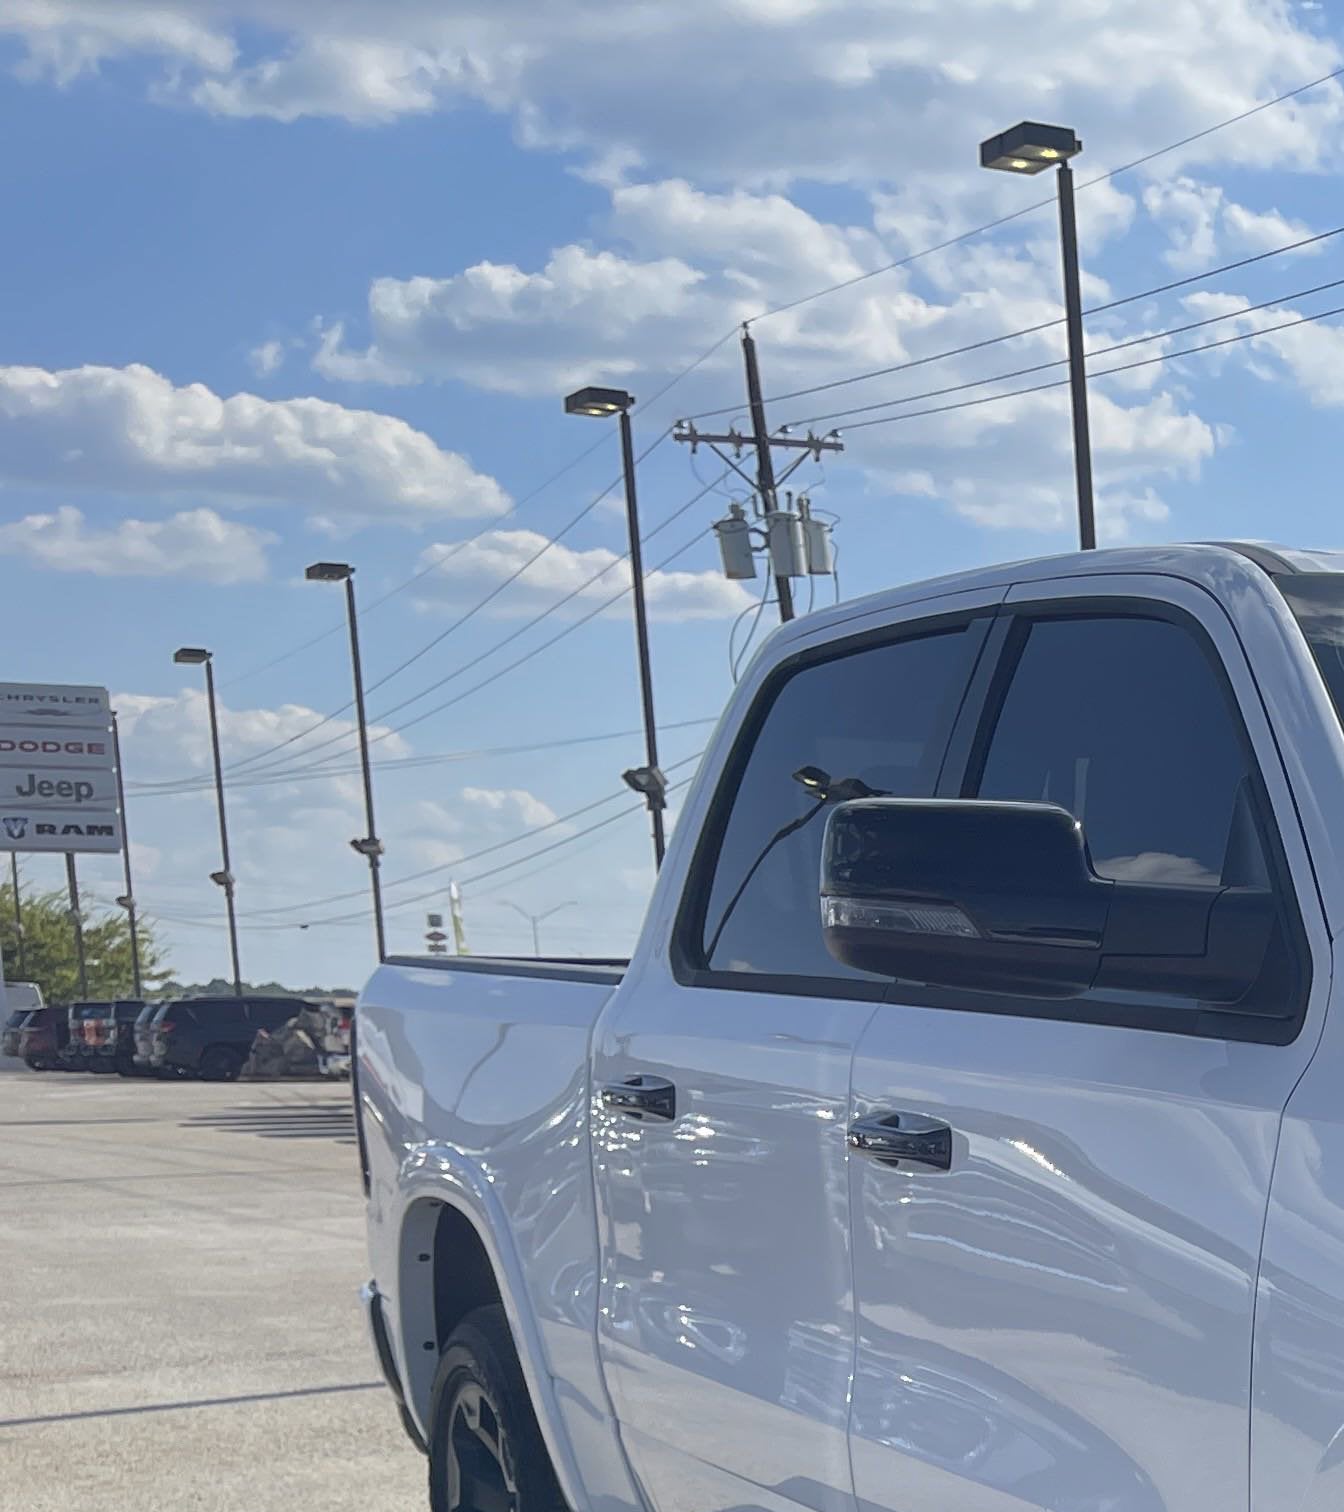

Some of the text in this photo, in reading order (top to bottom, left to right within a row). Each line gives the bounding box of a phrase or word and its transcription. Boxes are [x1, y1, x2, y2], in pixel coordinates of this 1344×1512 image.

[0, 740, 105, 755] DODGE
[16, 774, 94, 802] Jeep
[36, 824, 114, 836] RAM
